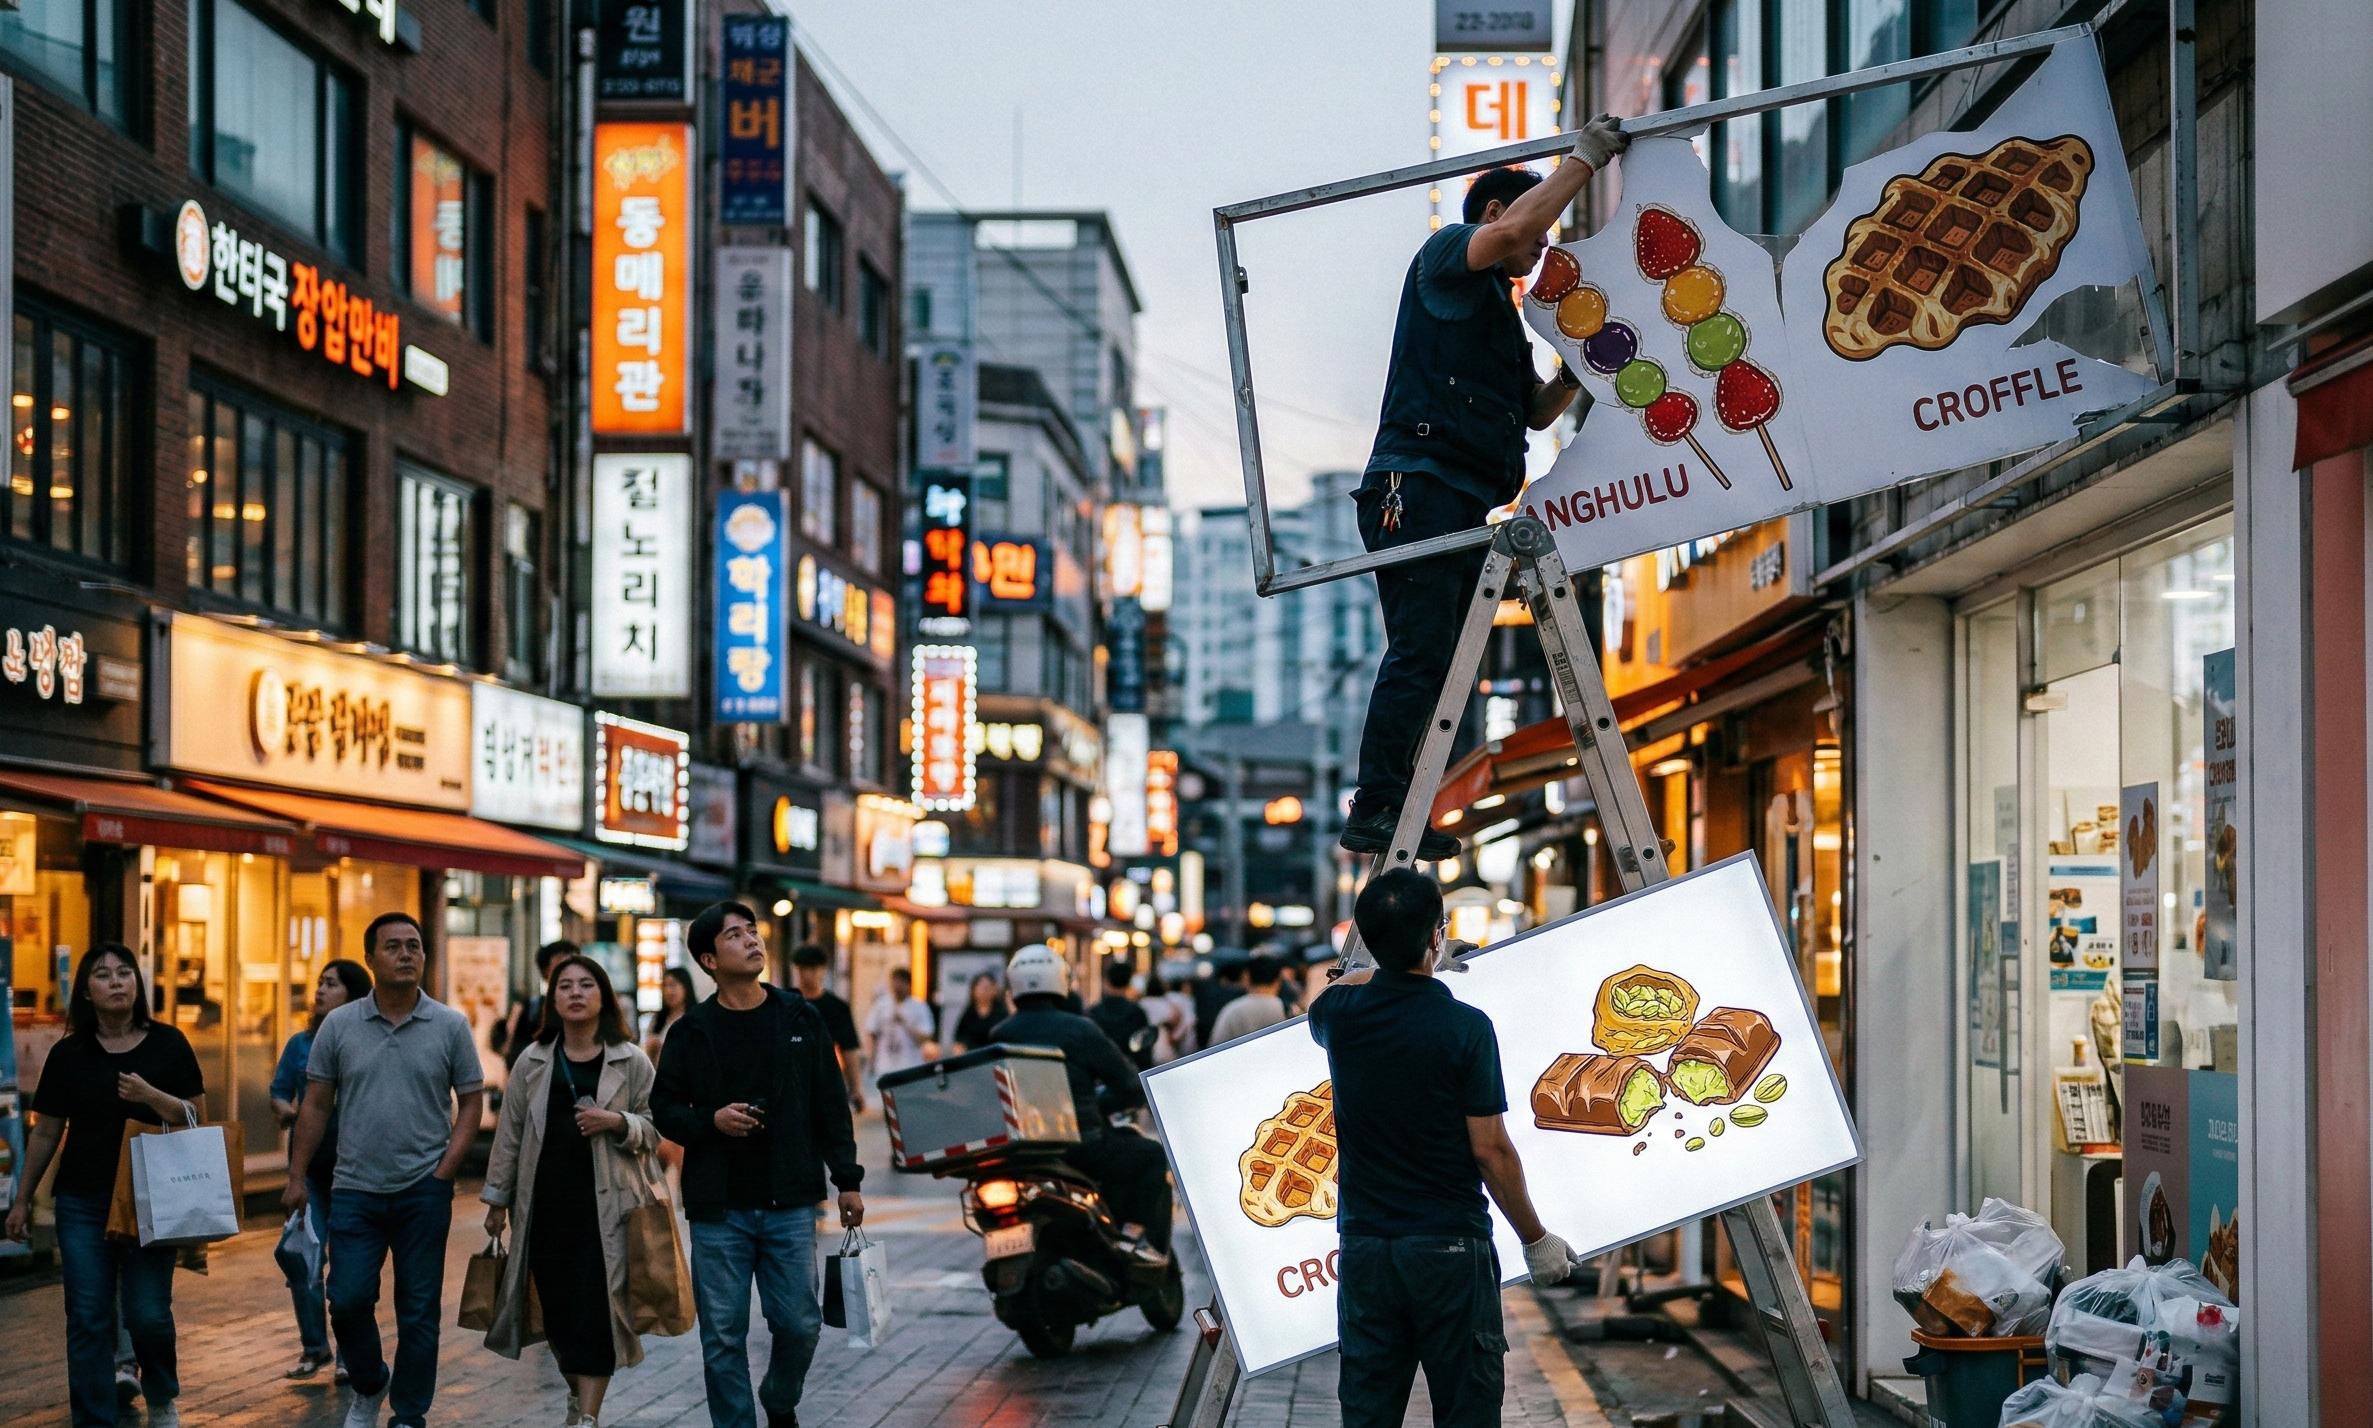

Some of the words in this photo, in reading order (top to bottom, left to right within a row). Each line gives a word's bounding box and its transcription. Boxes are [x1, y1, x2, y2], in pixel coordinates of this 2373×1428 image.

[731, 97, 779, 148] 버
[1466, 81, 1527, 140] 데
[1913, 358, 2083, 432] CROFFLE
